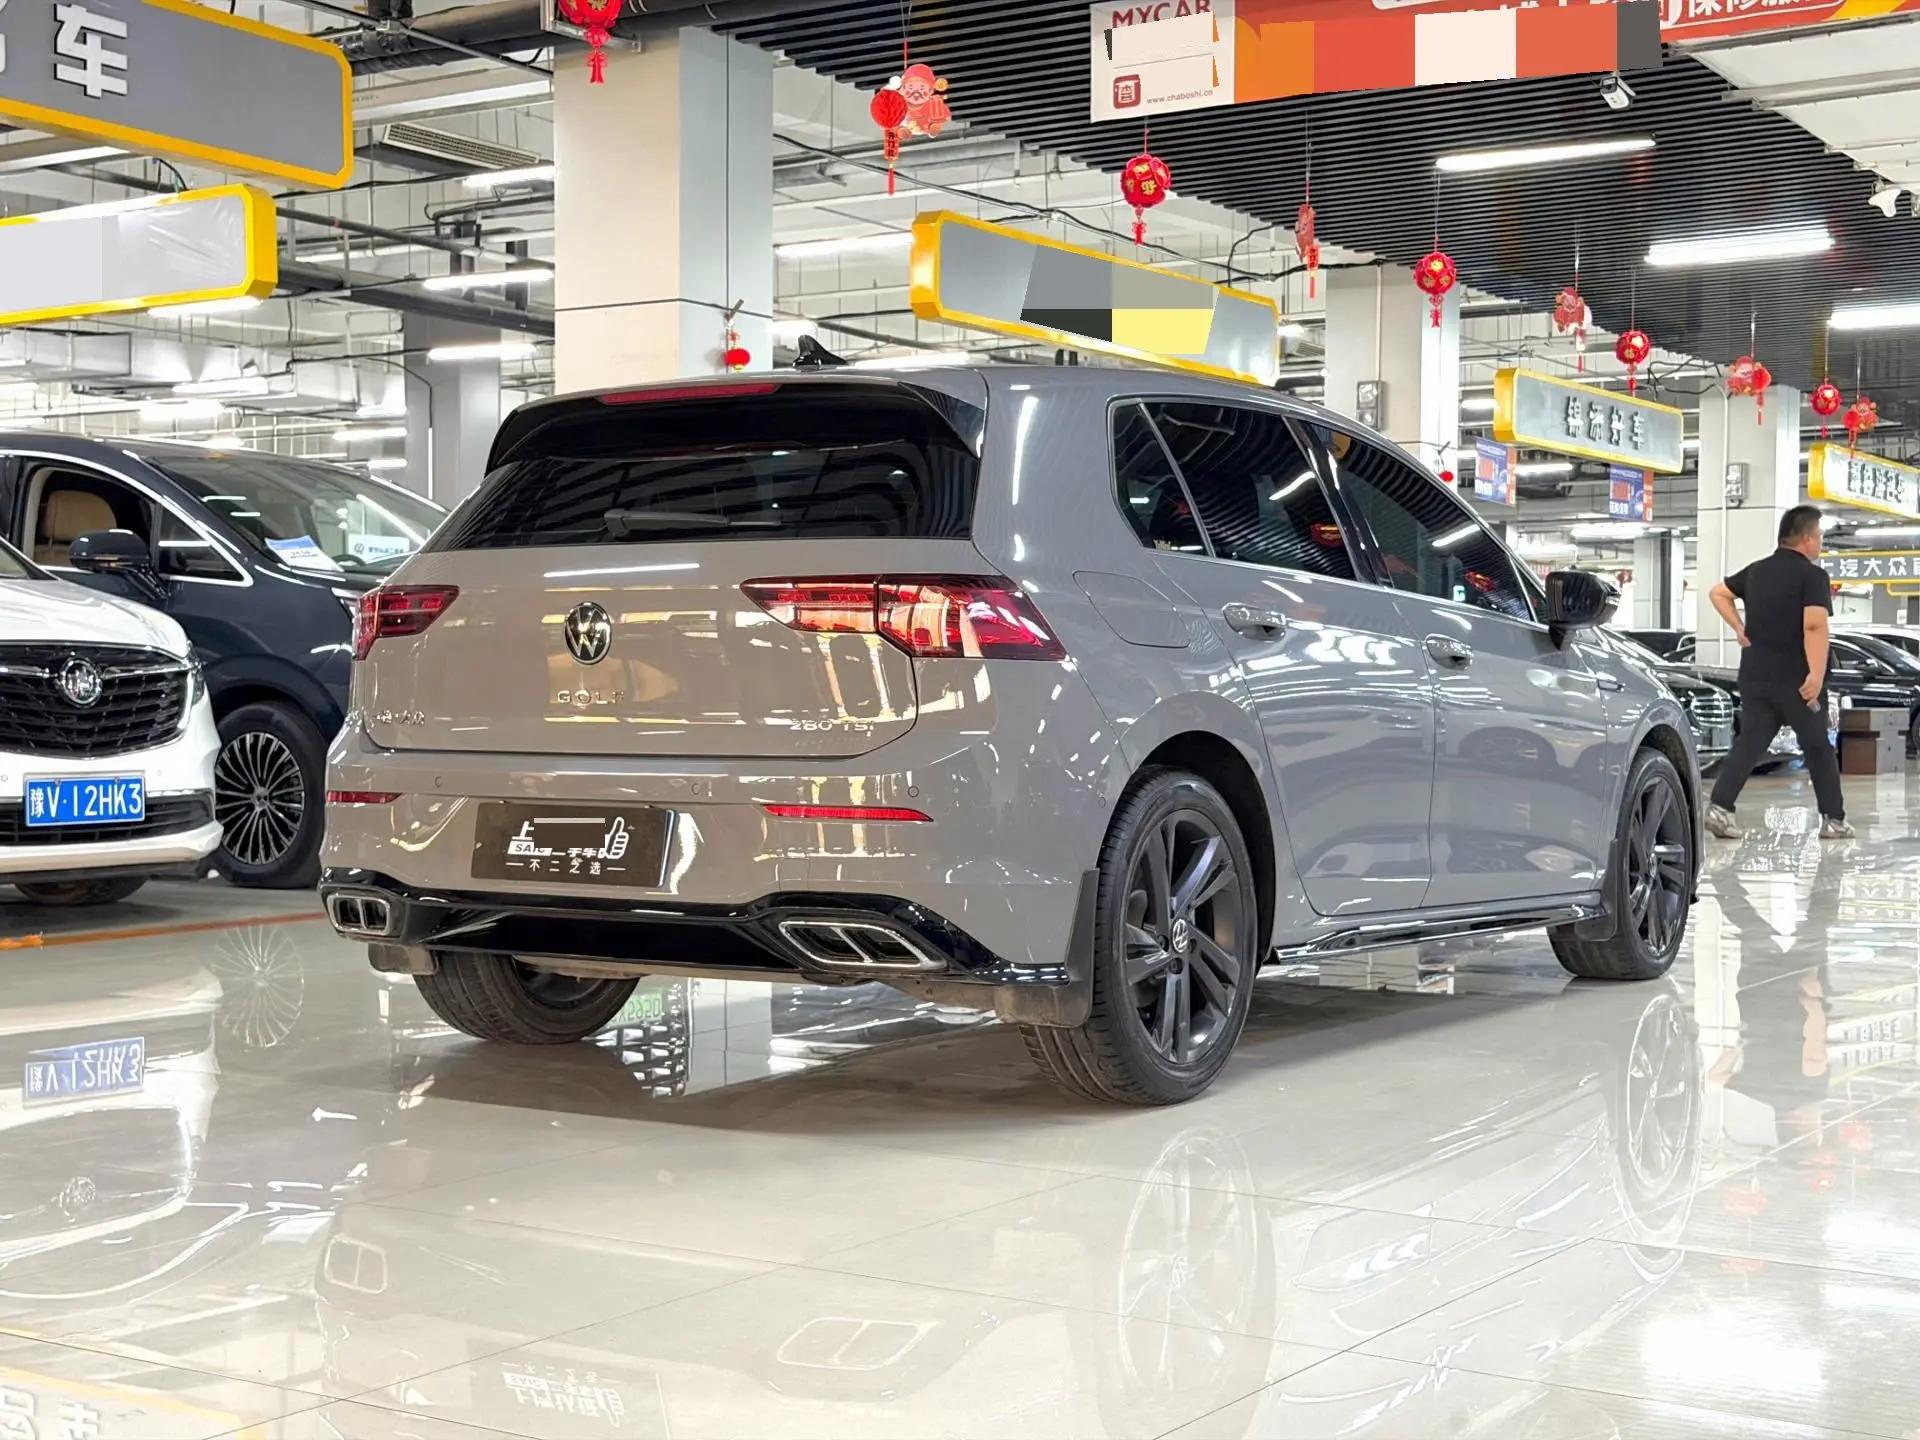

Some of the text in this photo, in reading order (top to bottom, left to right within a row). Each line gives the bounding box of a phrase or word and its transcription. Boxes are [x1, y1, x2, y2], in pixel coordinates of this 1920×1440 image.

[1112, 0, 1210, 28] MYCAR
[529, 859, 601, 875] 不二之选
